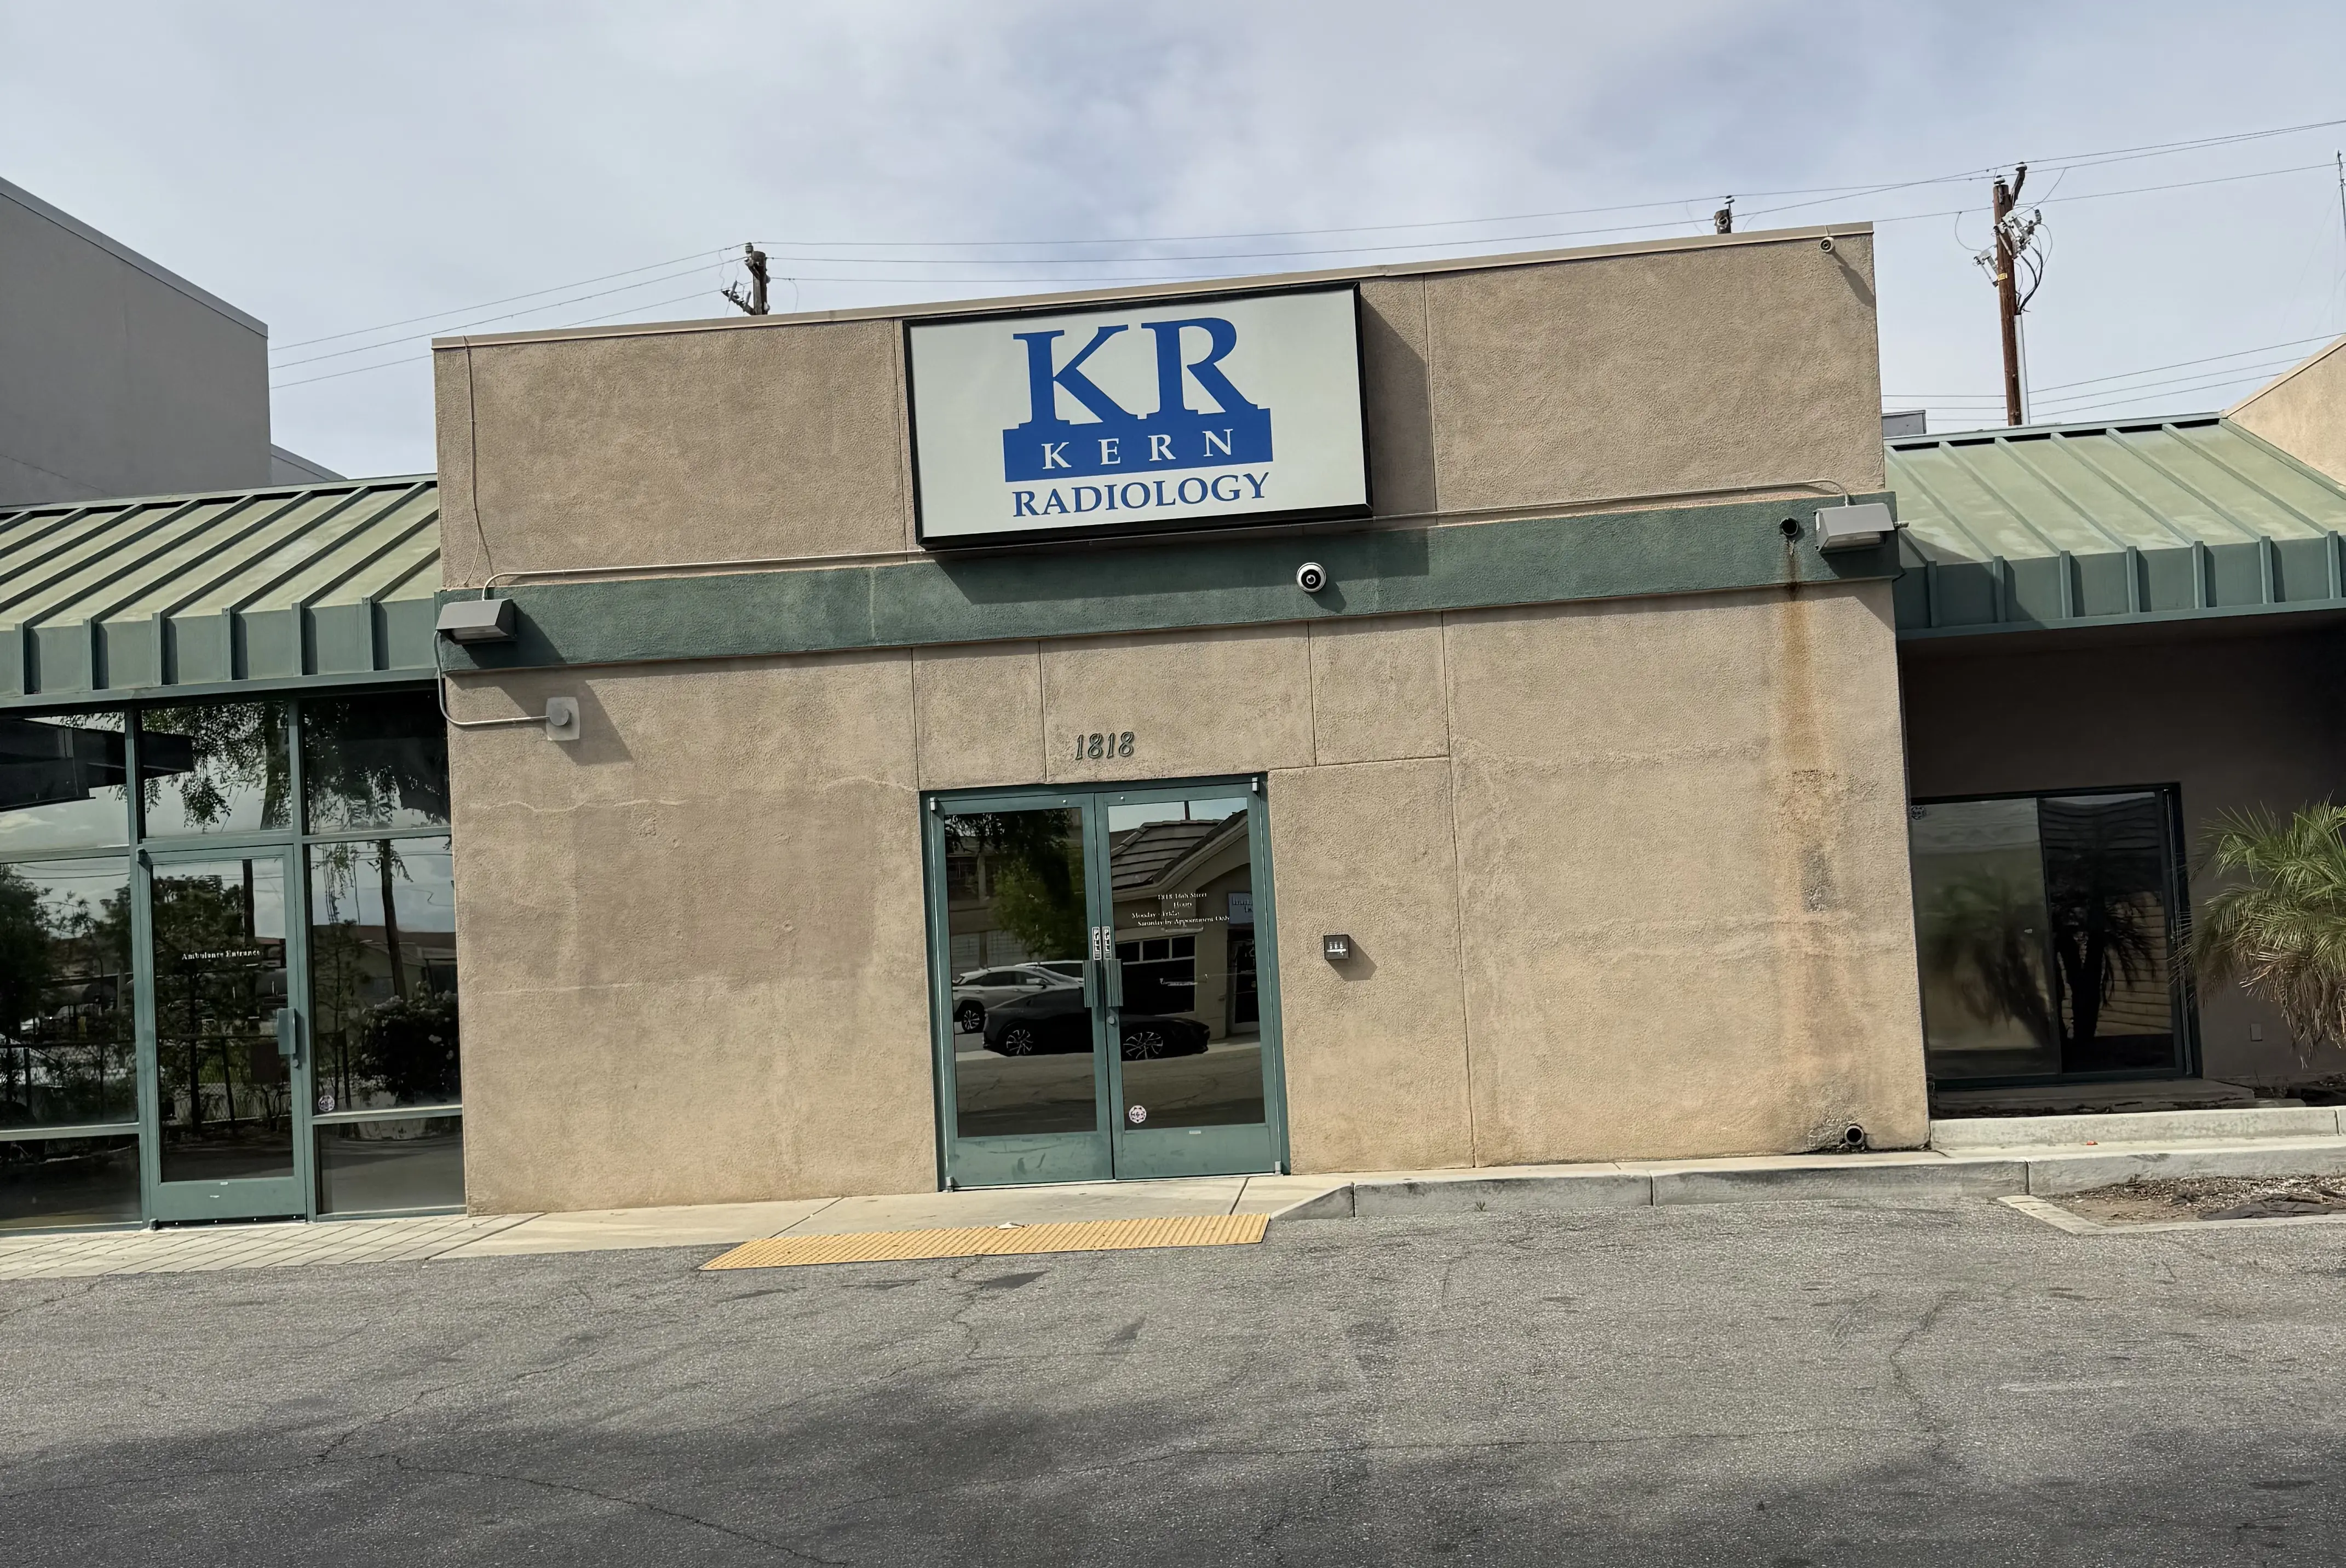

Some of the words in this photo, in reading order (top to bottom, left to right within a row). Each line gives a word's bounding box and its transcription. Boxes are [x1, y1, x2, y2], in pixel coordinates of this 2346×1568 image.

[1013, 318, 1257, 427] KR
[1042, 428, 1233, 470] KERN
[1013, 472, 1269, 517] RADIOLOGY
[1075, 731, 1135, 760] 1818
[1132, 911, 1156, 919] Monday
[1174, 917, 1214, 927] Appointment
[182, 952, 223, 960] Ambulance
[226, 949, 260, 958] Entrance
